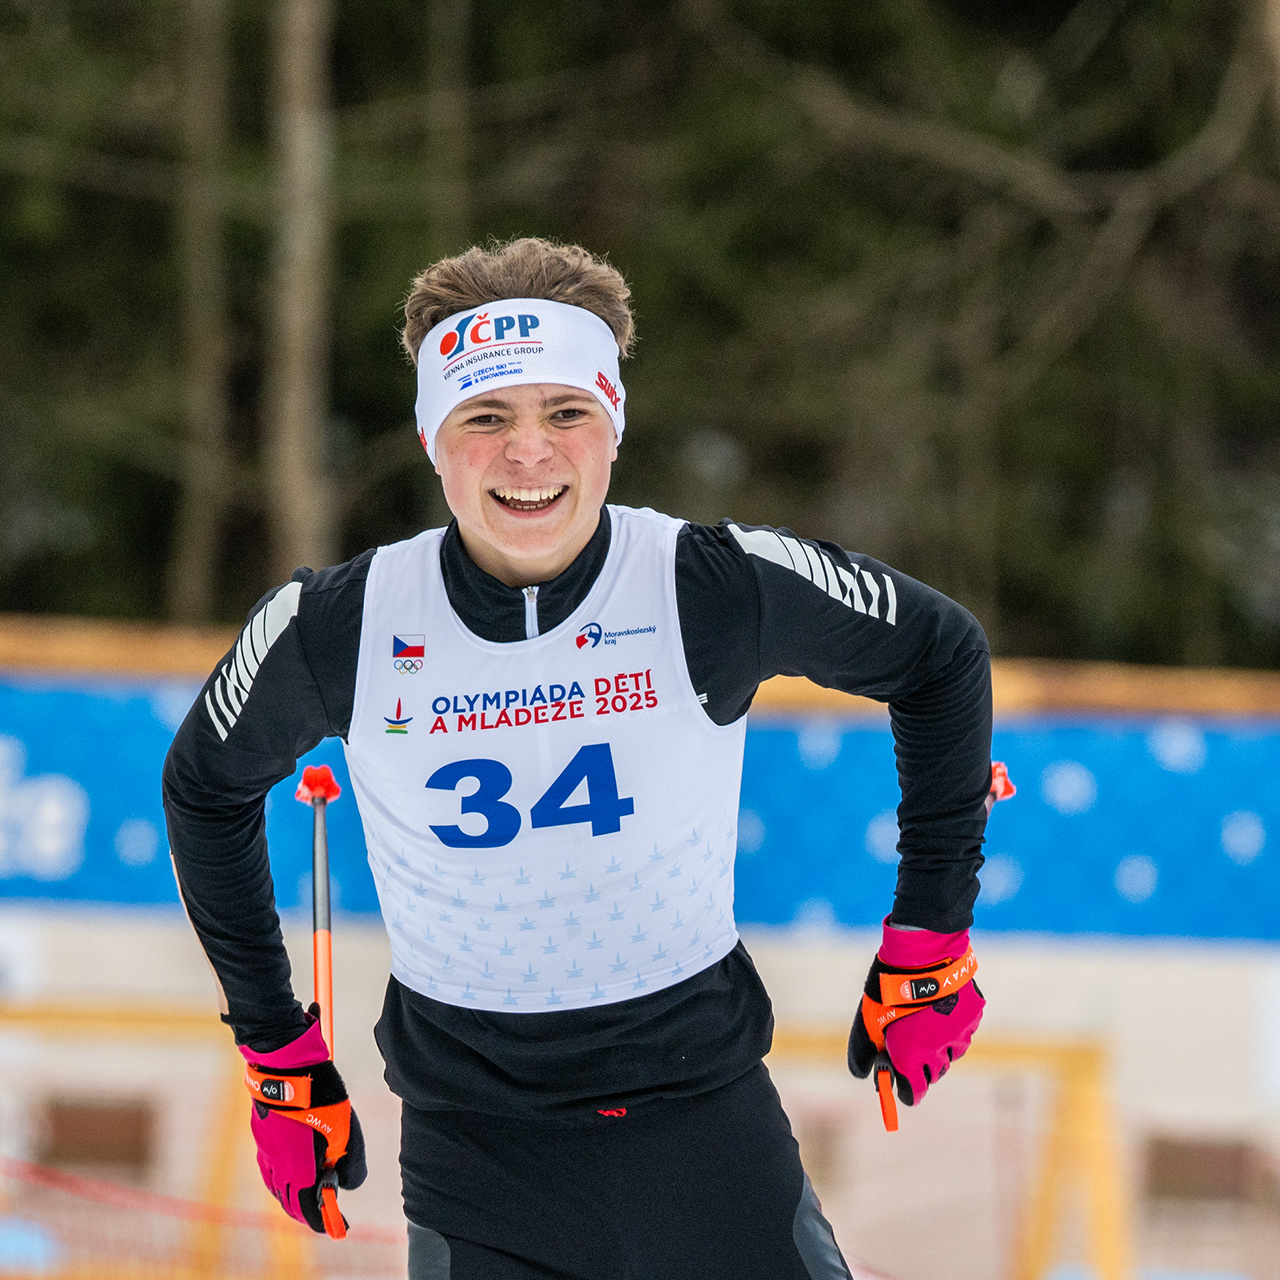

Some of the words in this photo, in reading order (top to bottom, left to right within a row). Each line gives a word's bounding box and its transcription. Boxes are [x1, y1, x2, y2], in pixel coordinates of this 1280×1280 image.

[470, 312, 540, 344] ČPP
[443, 362, 465, 381] VIENNA
[465, 348, 512, 367] INSURANCE
[514, 346, 544, 355] GROUP
[473, 366, 495, 378] CZECH
[495, 363, 507, 371] SKI
[480, 368, 523, 382] SNOWBOARD
[604, 625, 657, 638] Moravskoslezský
[604, 638, 617, 646] kraj
[431, 681, 585, 715] OLYMPIÁDA
[594, 669, 652, 696] DĚTÍ
[429, 716, 449, 734] A
[457, 701, 584, 732] MLÁDEŽE
[595, 690, 658, 716] 2025
[425, 742, 634, 849] 34
